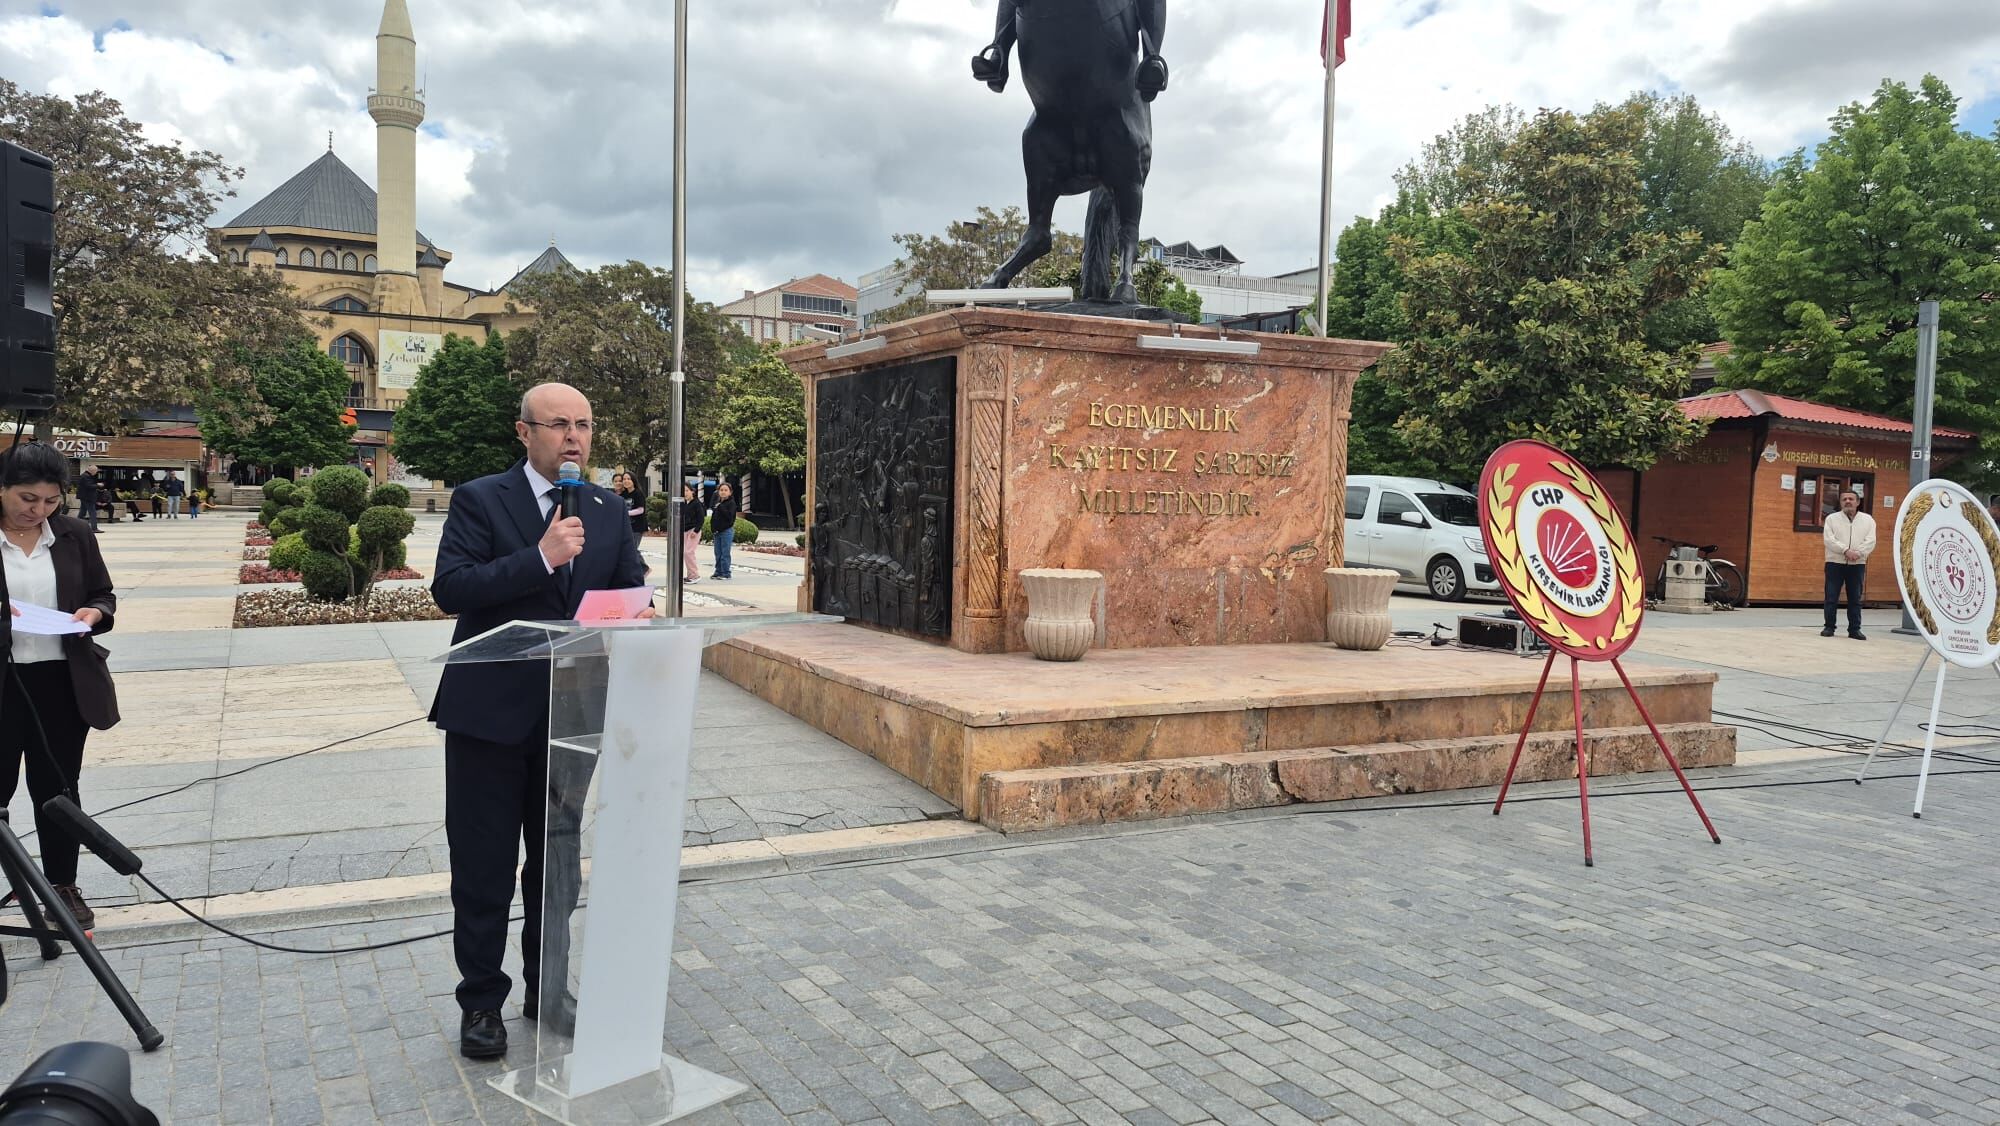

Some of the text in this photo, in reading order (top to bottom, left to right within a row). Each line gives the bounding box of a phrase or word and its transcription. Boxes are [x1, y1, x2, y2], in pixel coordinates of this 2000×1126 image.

[1089, 402, 1239, 433] EGEMENLİK
[54, 436, 109, 452] ÖZSÜT
[1049, 443, 1294, 478] KAYITSIZ ŞARTSIZ
[1532, 488, 1564, 507] CHP
[1529, 546, 1611, 607] KIRŞEHİR İL BAŞKANLIĞI
